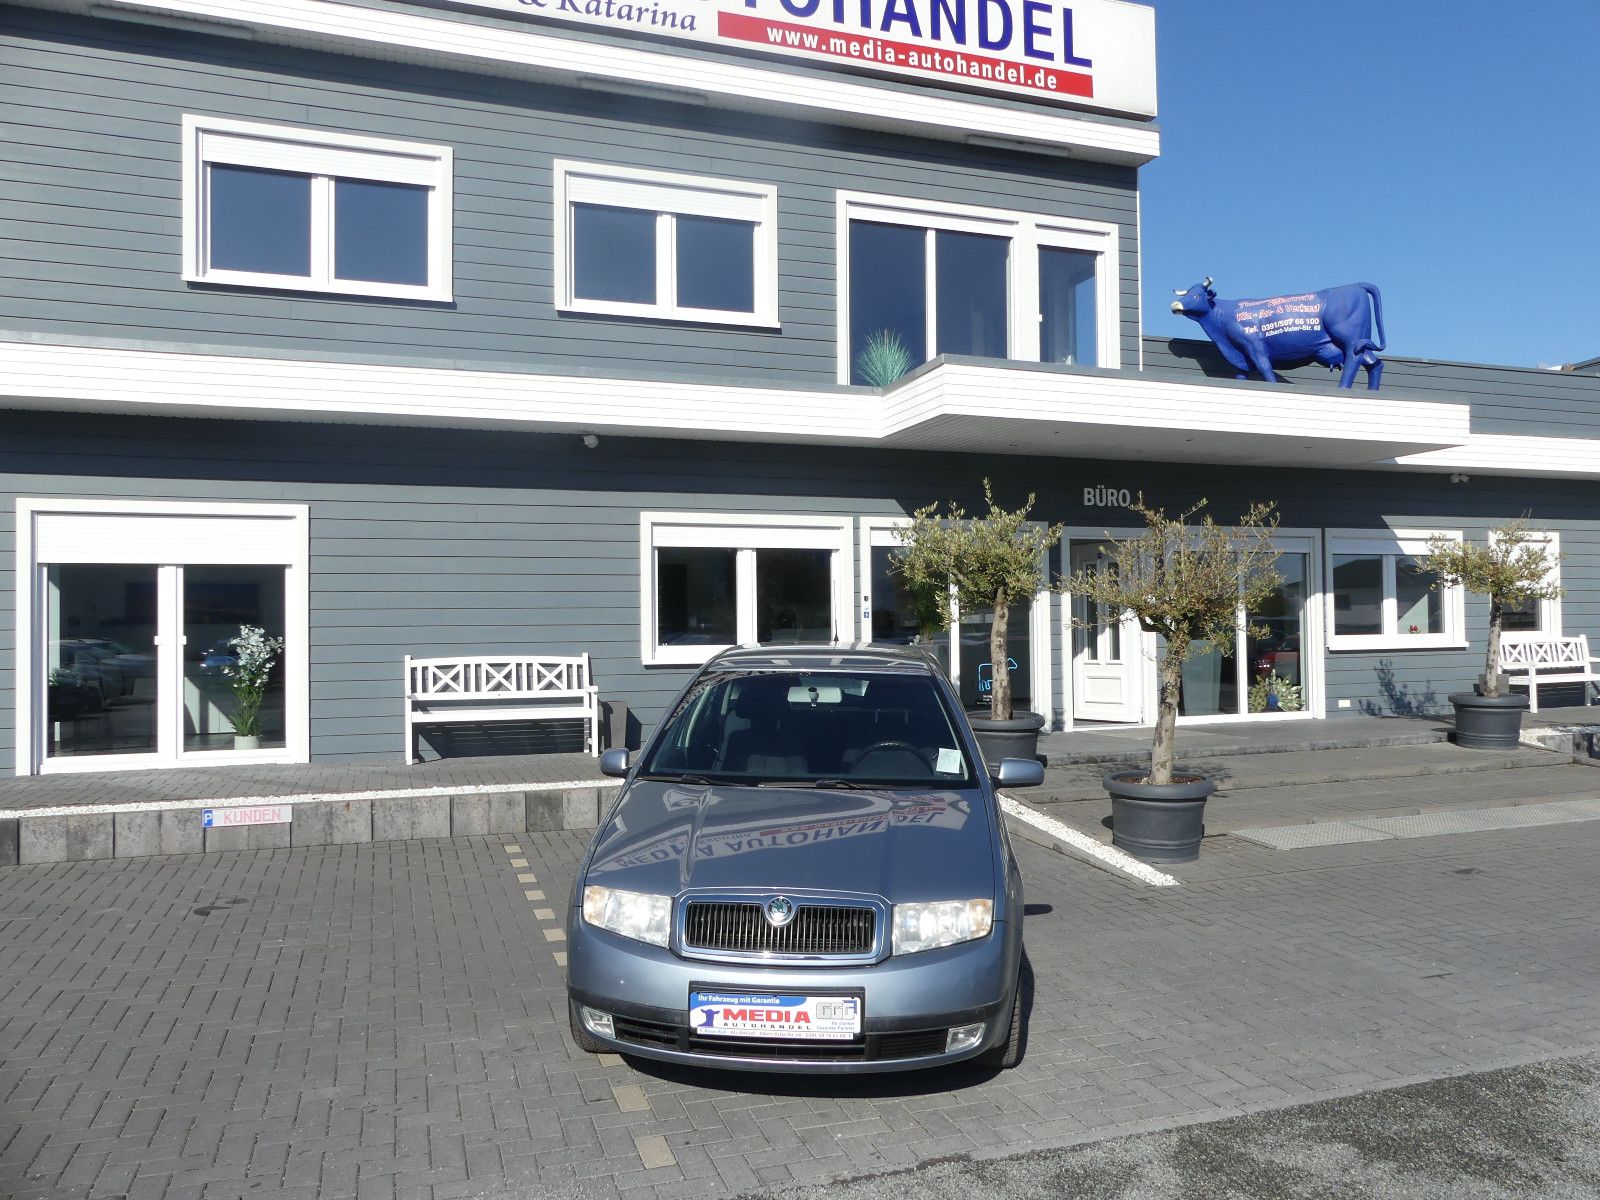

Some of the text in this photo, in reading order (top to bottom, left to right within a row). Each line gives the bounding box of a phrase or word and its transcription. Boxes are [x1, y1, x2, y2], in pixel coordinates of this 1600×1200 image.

[766, 27, 1058, 89] www.media-autohandel.de
[1306, 317, 1319, 325] 100
[1083, 485, 1130, 507] BÜRO
[224, 807, 281, 824] KUNDEN
[709, 996, 738, 1004] Fahrzeug
[723, 1008, 811, 1023] MEDIA
[723, 1022, 811, 1030] AUTOHANDEL
